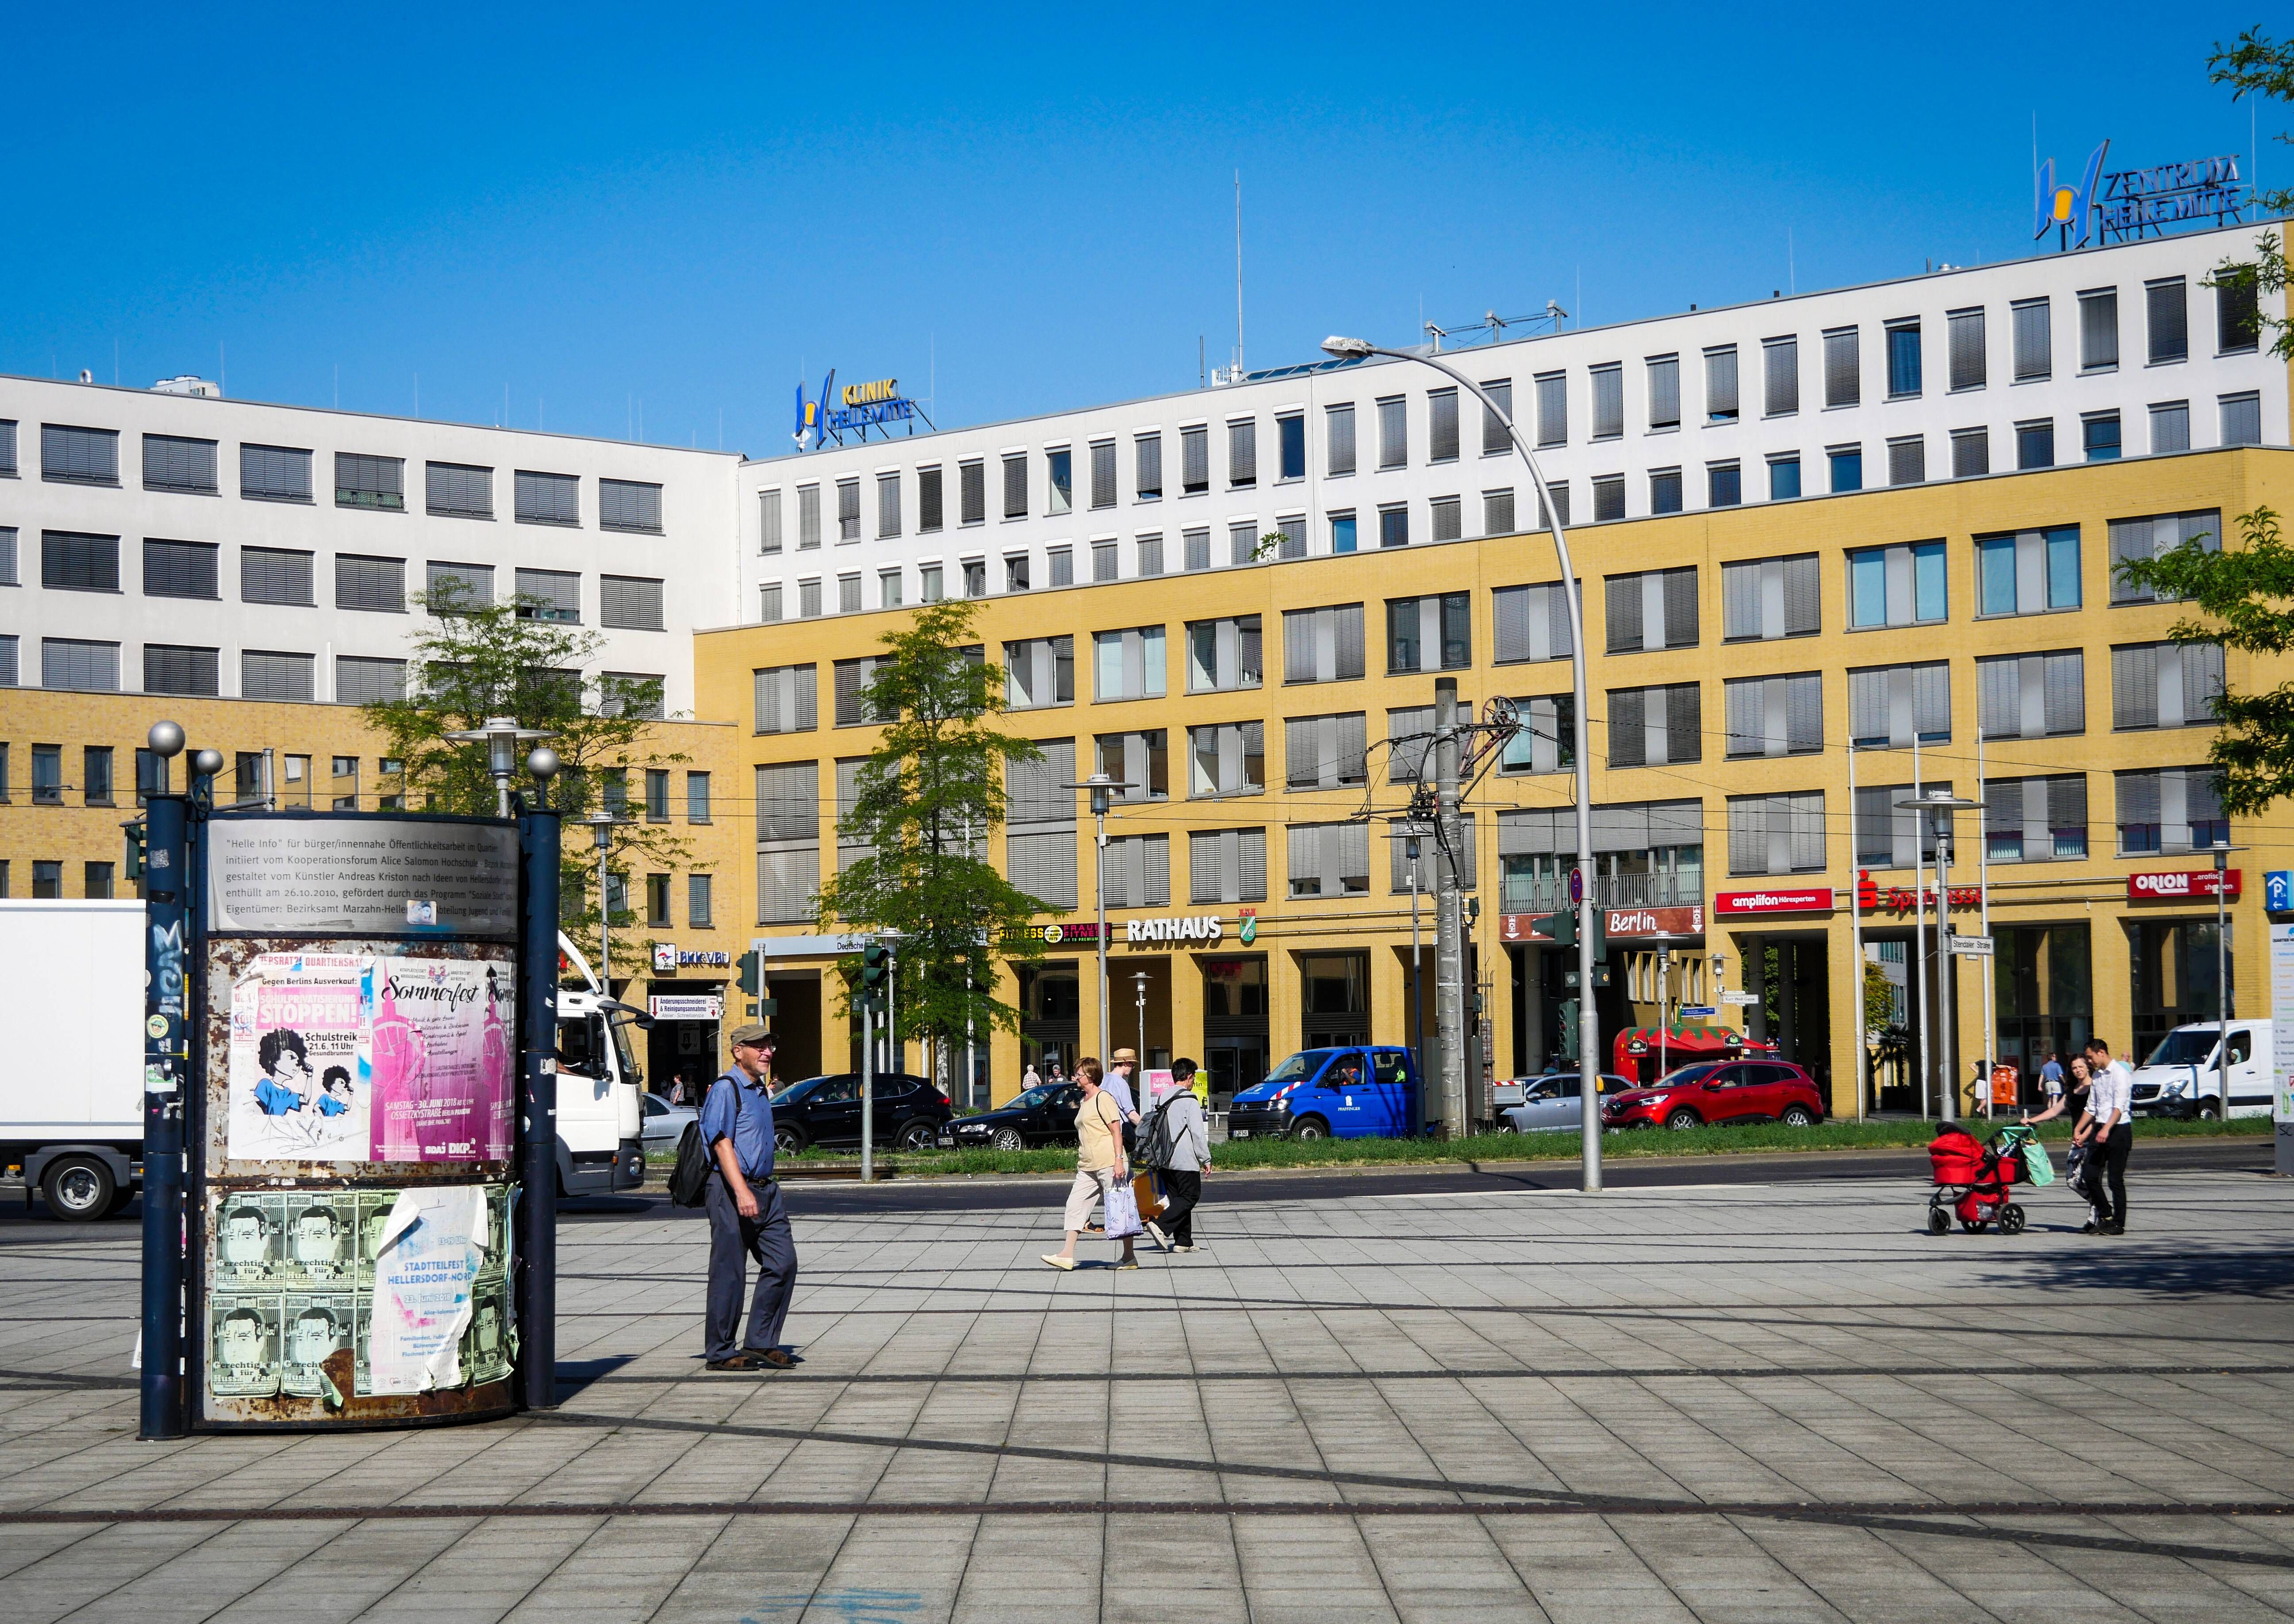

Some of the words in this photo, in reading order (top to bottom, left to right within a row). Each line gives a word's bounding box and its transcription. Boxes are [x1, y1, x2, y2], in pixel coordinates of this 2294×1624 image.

[2103, 155, 2240, 201] ZENTRUM
[2103, 199, 2168, 231] HELLE
[2172, 186, 2240, 221] MITTE
[843, 379, 897, 405] KLINIK
[872, 400, 912, 423] MITTE
[227, 839, 255, 847] "Helle
[259, 839, 282, 847] Info"
[288, 839, 300, 847] für
[304, 839, 385, 849] bürger/innennahe
[389, 839, 465, 851] Öffentlichkeitsarbeit
[226, 856, 259, 864] initiiert
[288, 855, 377, 866] Kooperationsforum
[381, 856, 401, 865] Alice
[405, 857, 439, 866] Salomon
[442, 858, 478, 867] Hochschule
[226, 872, 267, 882] gestaltet
[296, 872, 335, 880] Künstler
[339, 872, 375, 881] Andreas
[379, 872, 408, 881] Kriston
[412, 873, 430, 882] nach
[434, 874, 453, 882] Ideen
[470, 874, 502, 884] Hellersdorfer
[2136, 874, 2189, 894] ORION
[227, 888, 262, 897] enthüllt
[285, 888, 338, 897] 26.10.2010,
[343, 888, 384, 898] gefördert
[388, 889, 411, 897] durch
[414, 889, 427, 898] das
[431, 889, 466, 900] Programm
[2274, 883, 2282, 898] P
[1732, 894, 1778, 909] amplifon
[227, 904, 282, 915] Eigentümer:
[469, 907, 488, 916] Jugend
[1610, 912, 1656, 932] Berlin
[1128, 916, 1221, 941] RATHAUS
[837, 942, 864, 950] Deutsche
[261, 994, 356, 1004] SCHULPRIVATISIERUNG
[381, 975, 479, 1012] Sommerfest
[261, 1004, 357, 1024] STOPPEN!
[305, 1032, 358, 1041] Schulstreik
[385, 1101, 413, 1110] SAMSTAG
[428, 1099, 443, 1107] JUNI
[444, 1098, 457, 1107] 2018
[449, 1143, 470, 1154] DKP
[217, 1259, 284, 1268] Gerechtigkeit
[287, 1258, 354, 1267] Gerechtigkeit
[404, 1260, 464, 1271] STADTTEILFEST
[388, 1272, 472, 1285] HELLERSDORF-NORD
[419, 1294, 433, 1303] Juni
[435, 1293, 450, 1301] 2018
